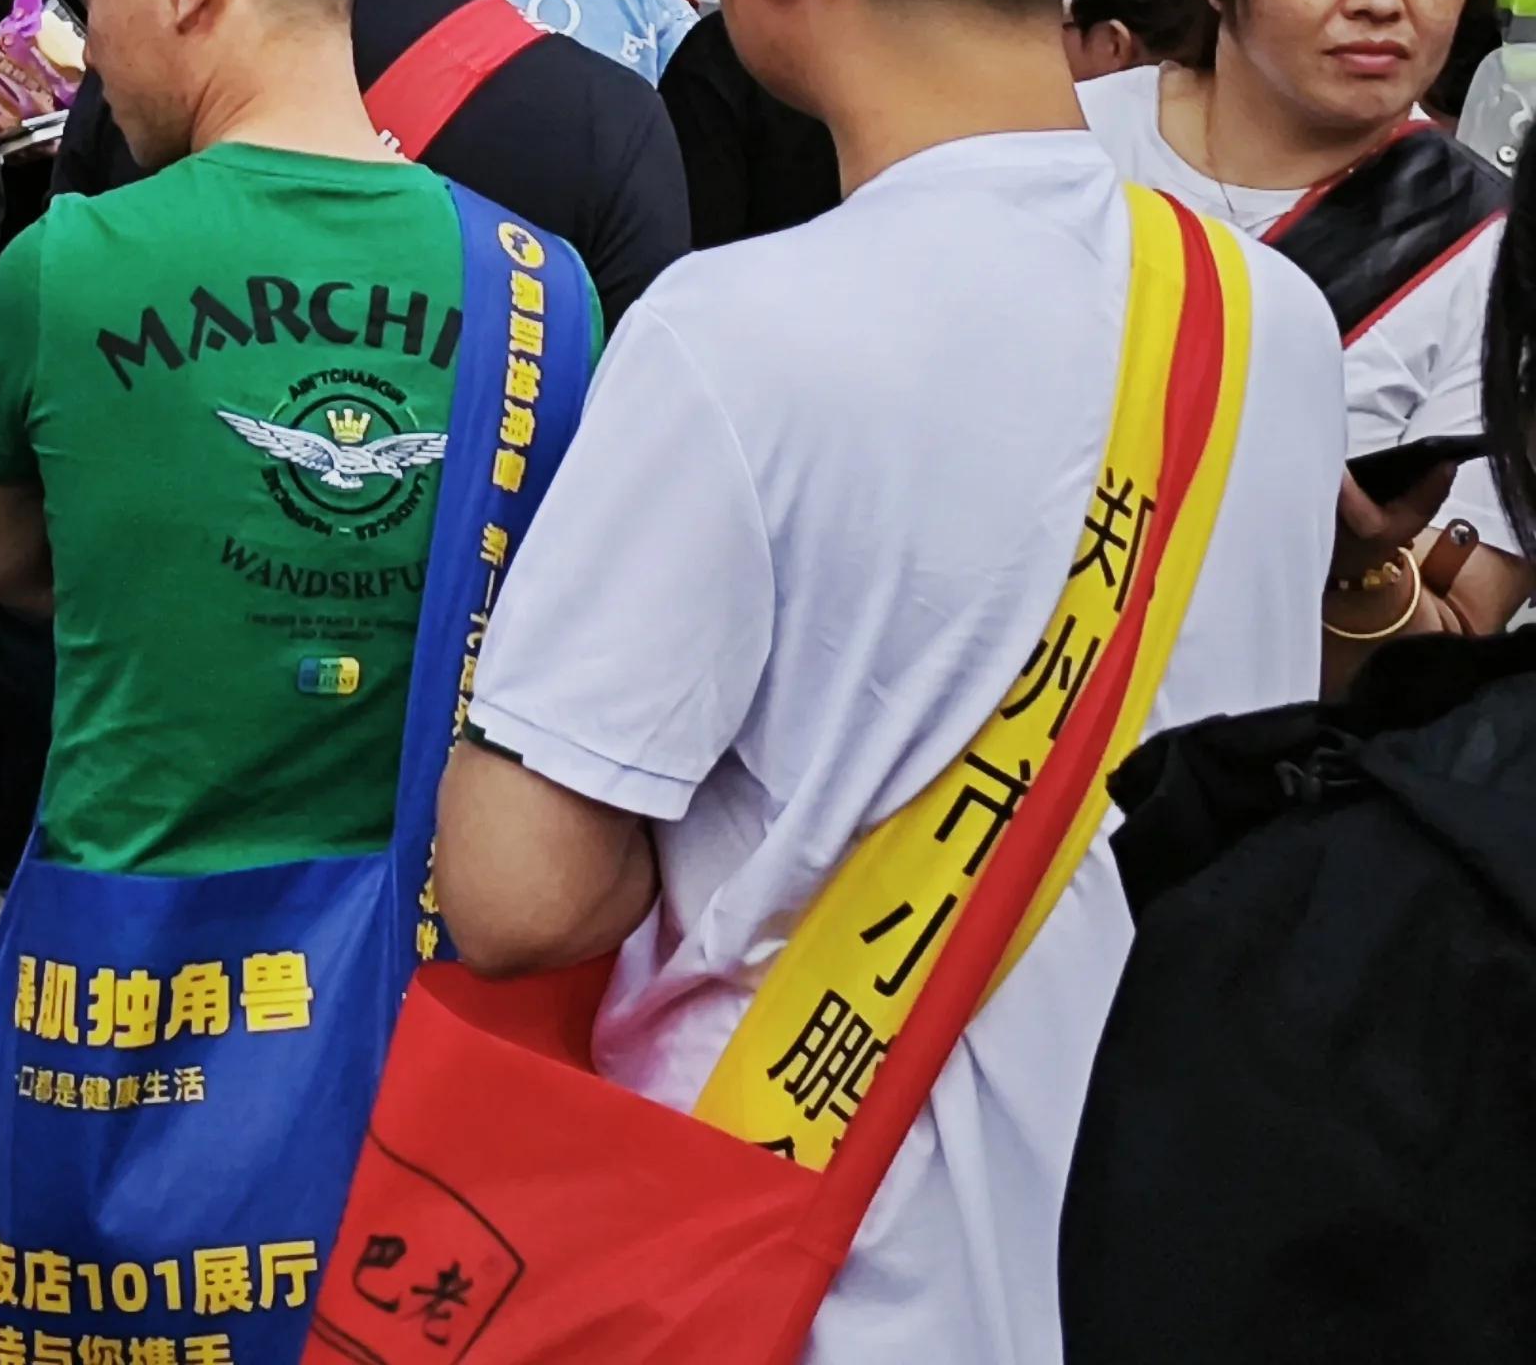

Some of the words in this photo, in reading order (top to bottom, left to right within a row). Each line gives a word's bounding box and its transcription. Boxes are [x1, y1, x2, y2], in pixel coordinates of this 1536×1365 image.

[760, 467, 1156, 1165] 郑州市小鹏
[15, 1065, 206, 1111] 口都是健康生活
